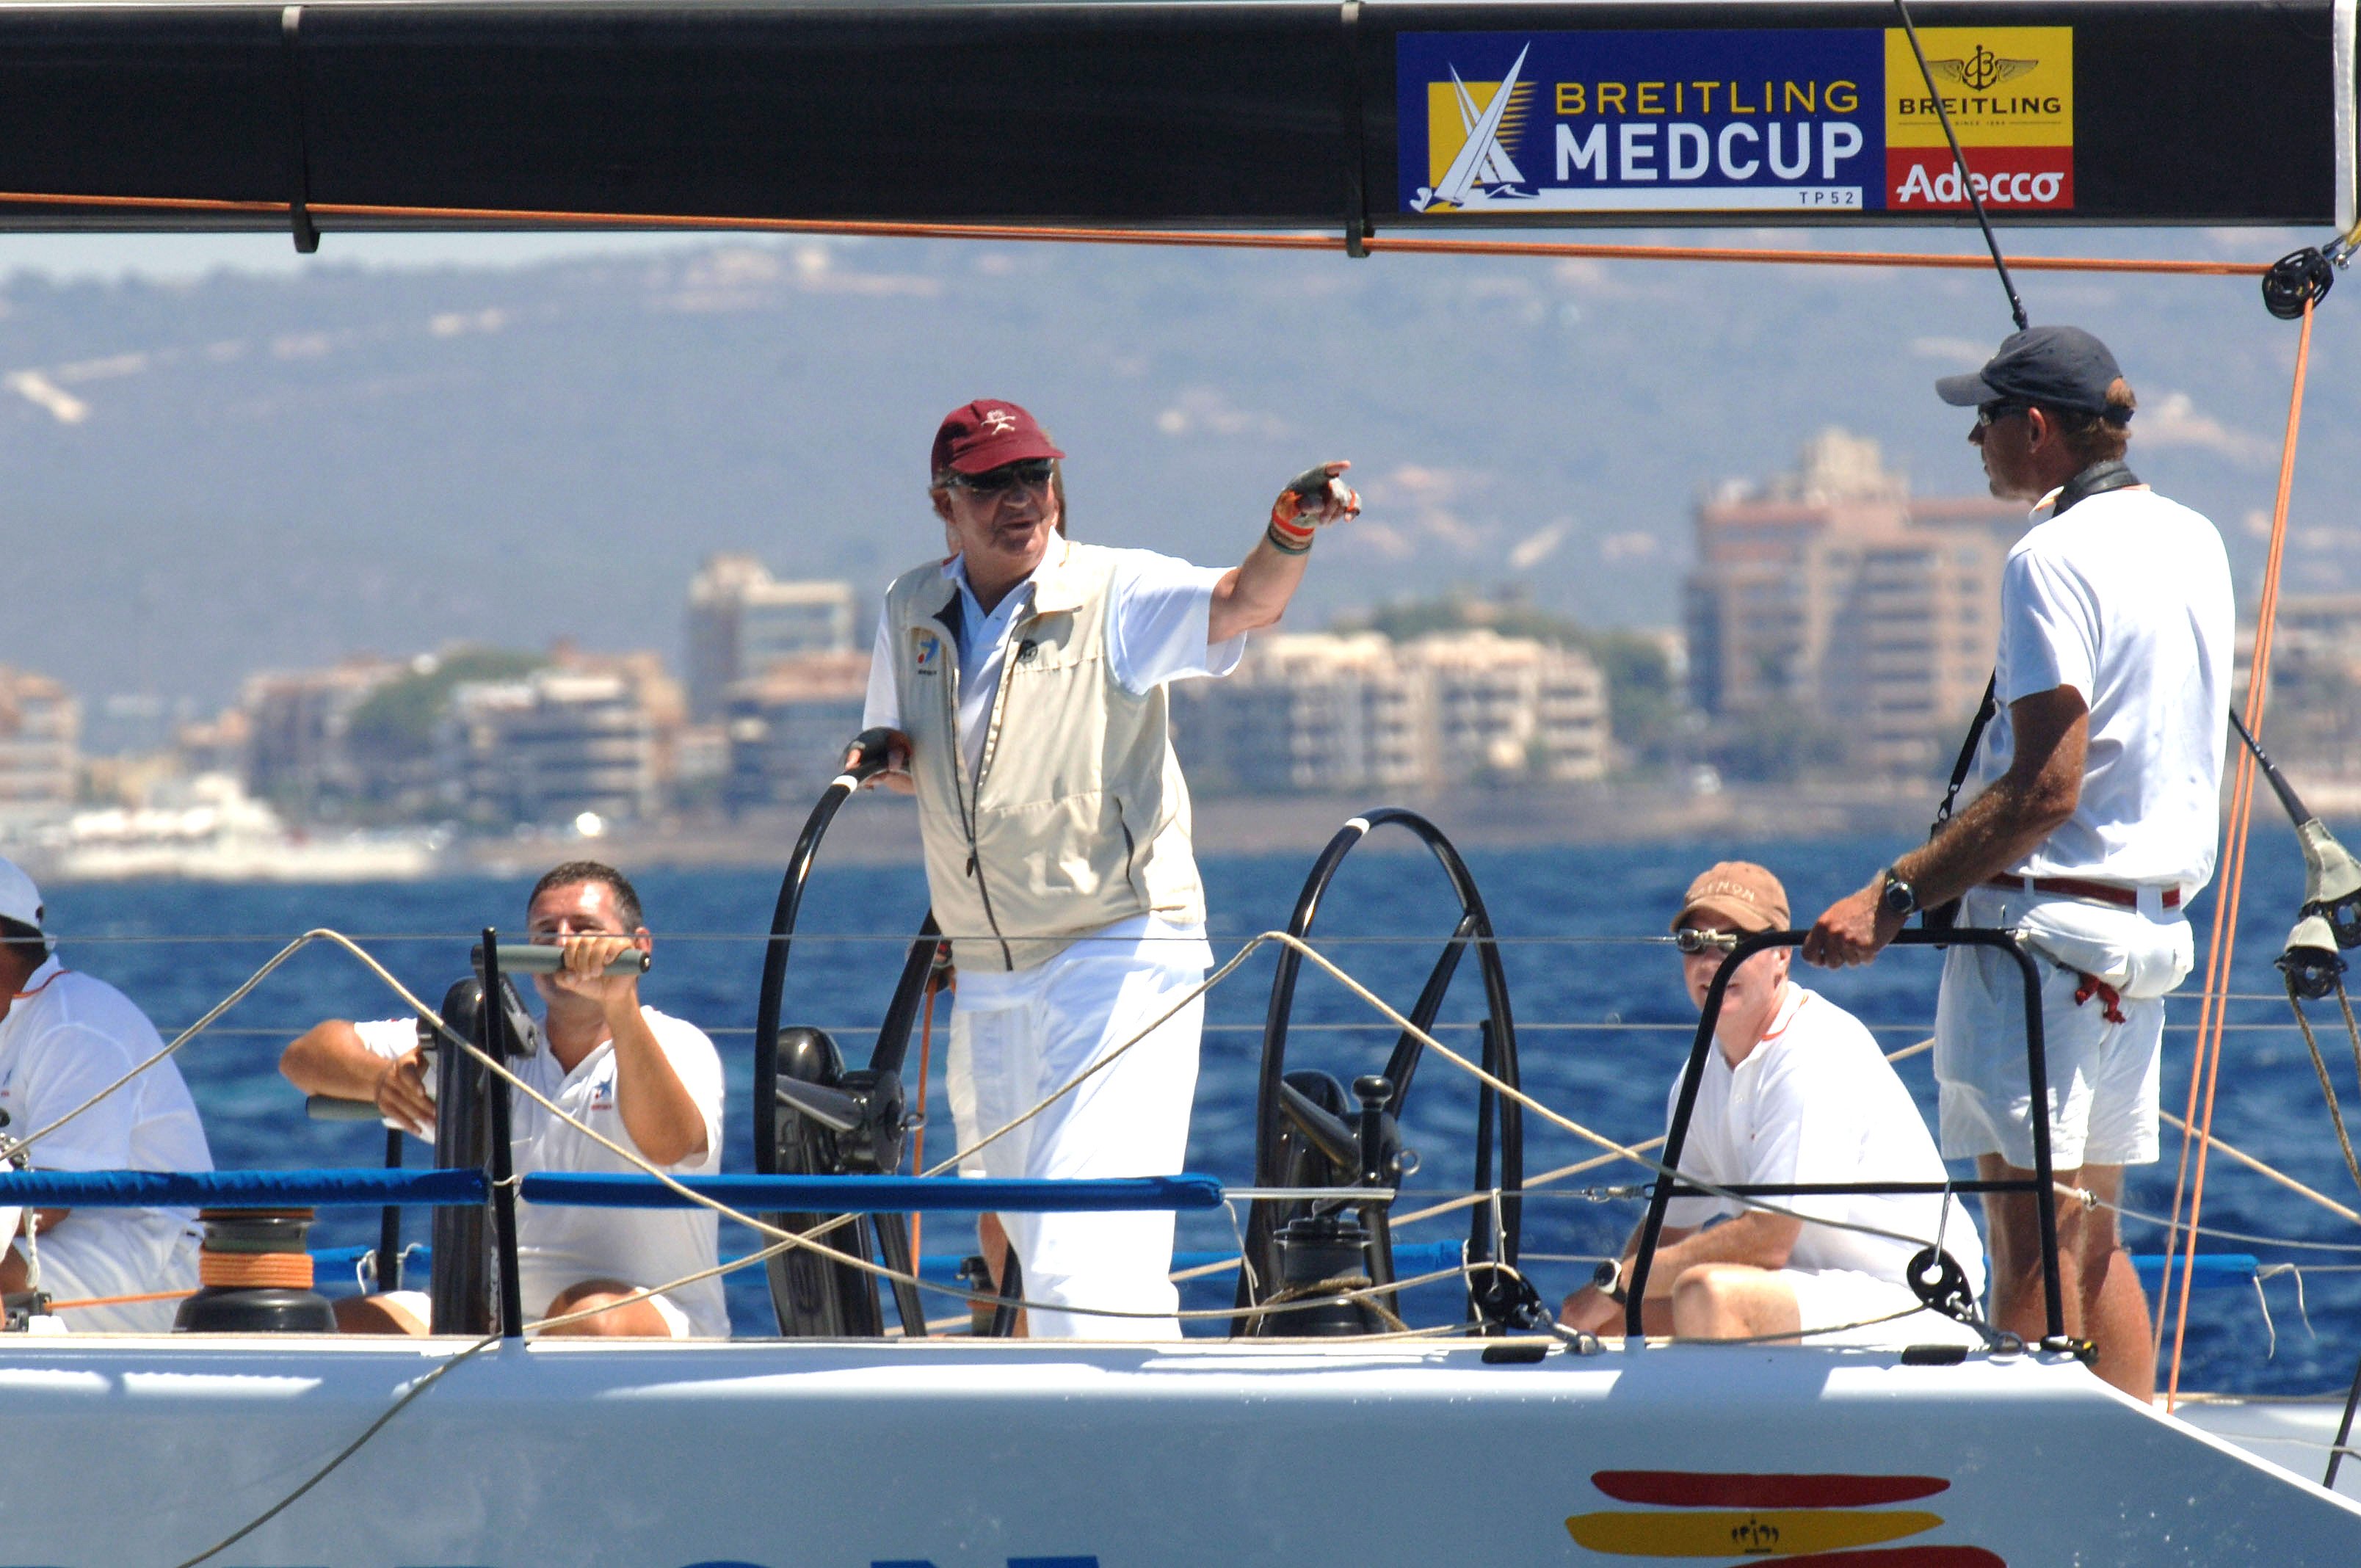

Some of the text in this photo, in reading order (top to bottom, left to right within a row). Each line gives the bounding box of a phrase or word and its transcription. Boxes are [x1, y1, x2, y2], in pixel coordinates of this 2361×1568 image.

[1555, 81, 1858, 115] BREITLING
[1898, 97, 2062, 115] BREITLING
[1555, 121, 1864, 182] MEDCUP
[1896, 160, 2065, 203] Adecco
